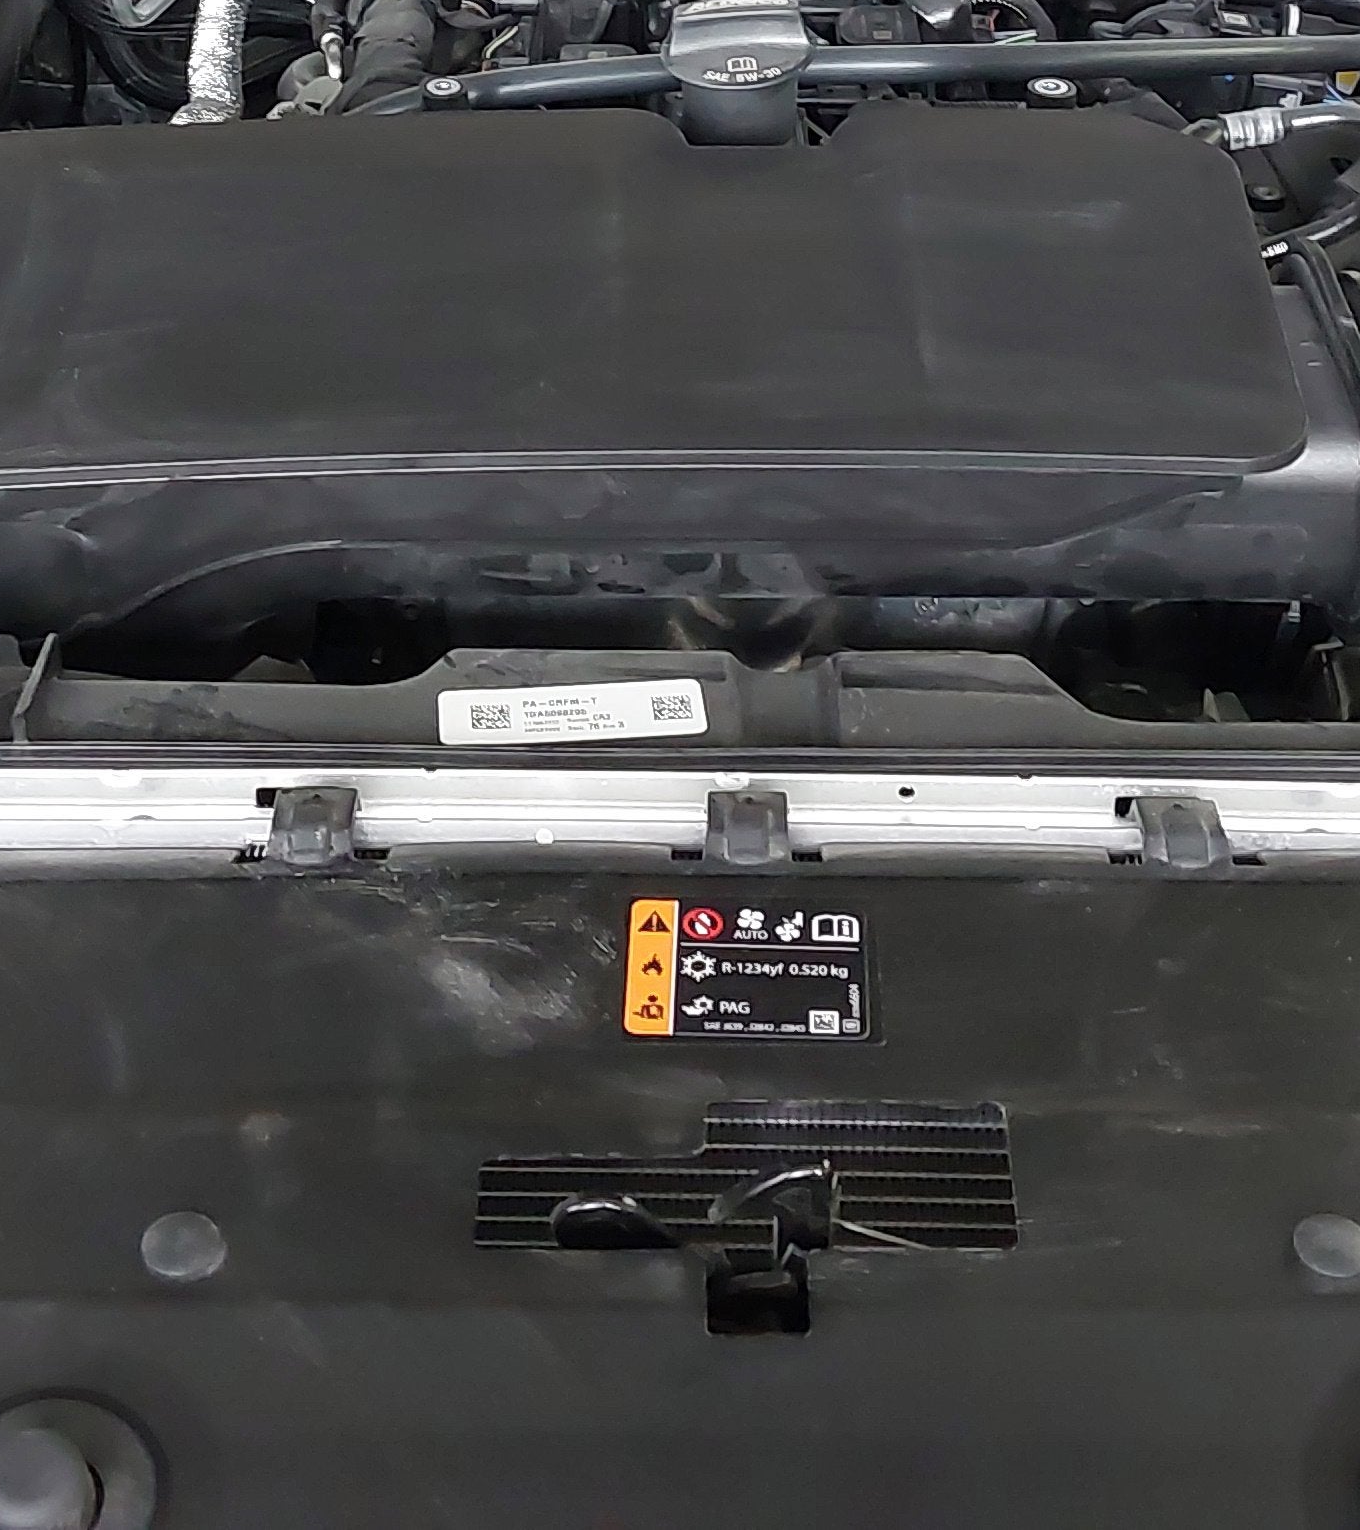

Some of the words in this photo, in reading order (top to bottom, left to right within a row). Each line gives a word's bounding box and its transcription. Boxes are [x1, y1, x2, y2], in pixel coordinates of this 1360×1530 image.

[733, 929, 769, 940] AUTO
[721, 961, 784, 977] R-1234yf
[789, 963, 828, 977] 0.520
[830, 964, 849, 979] kg
[720, 1000, 750, 1014] PAG
